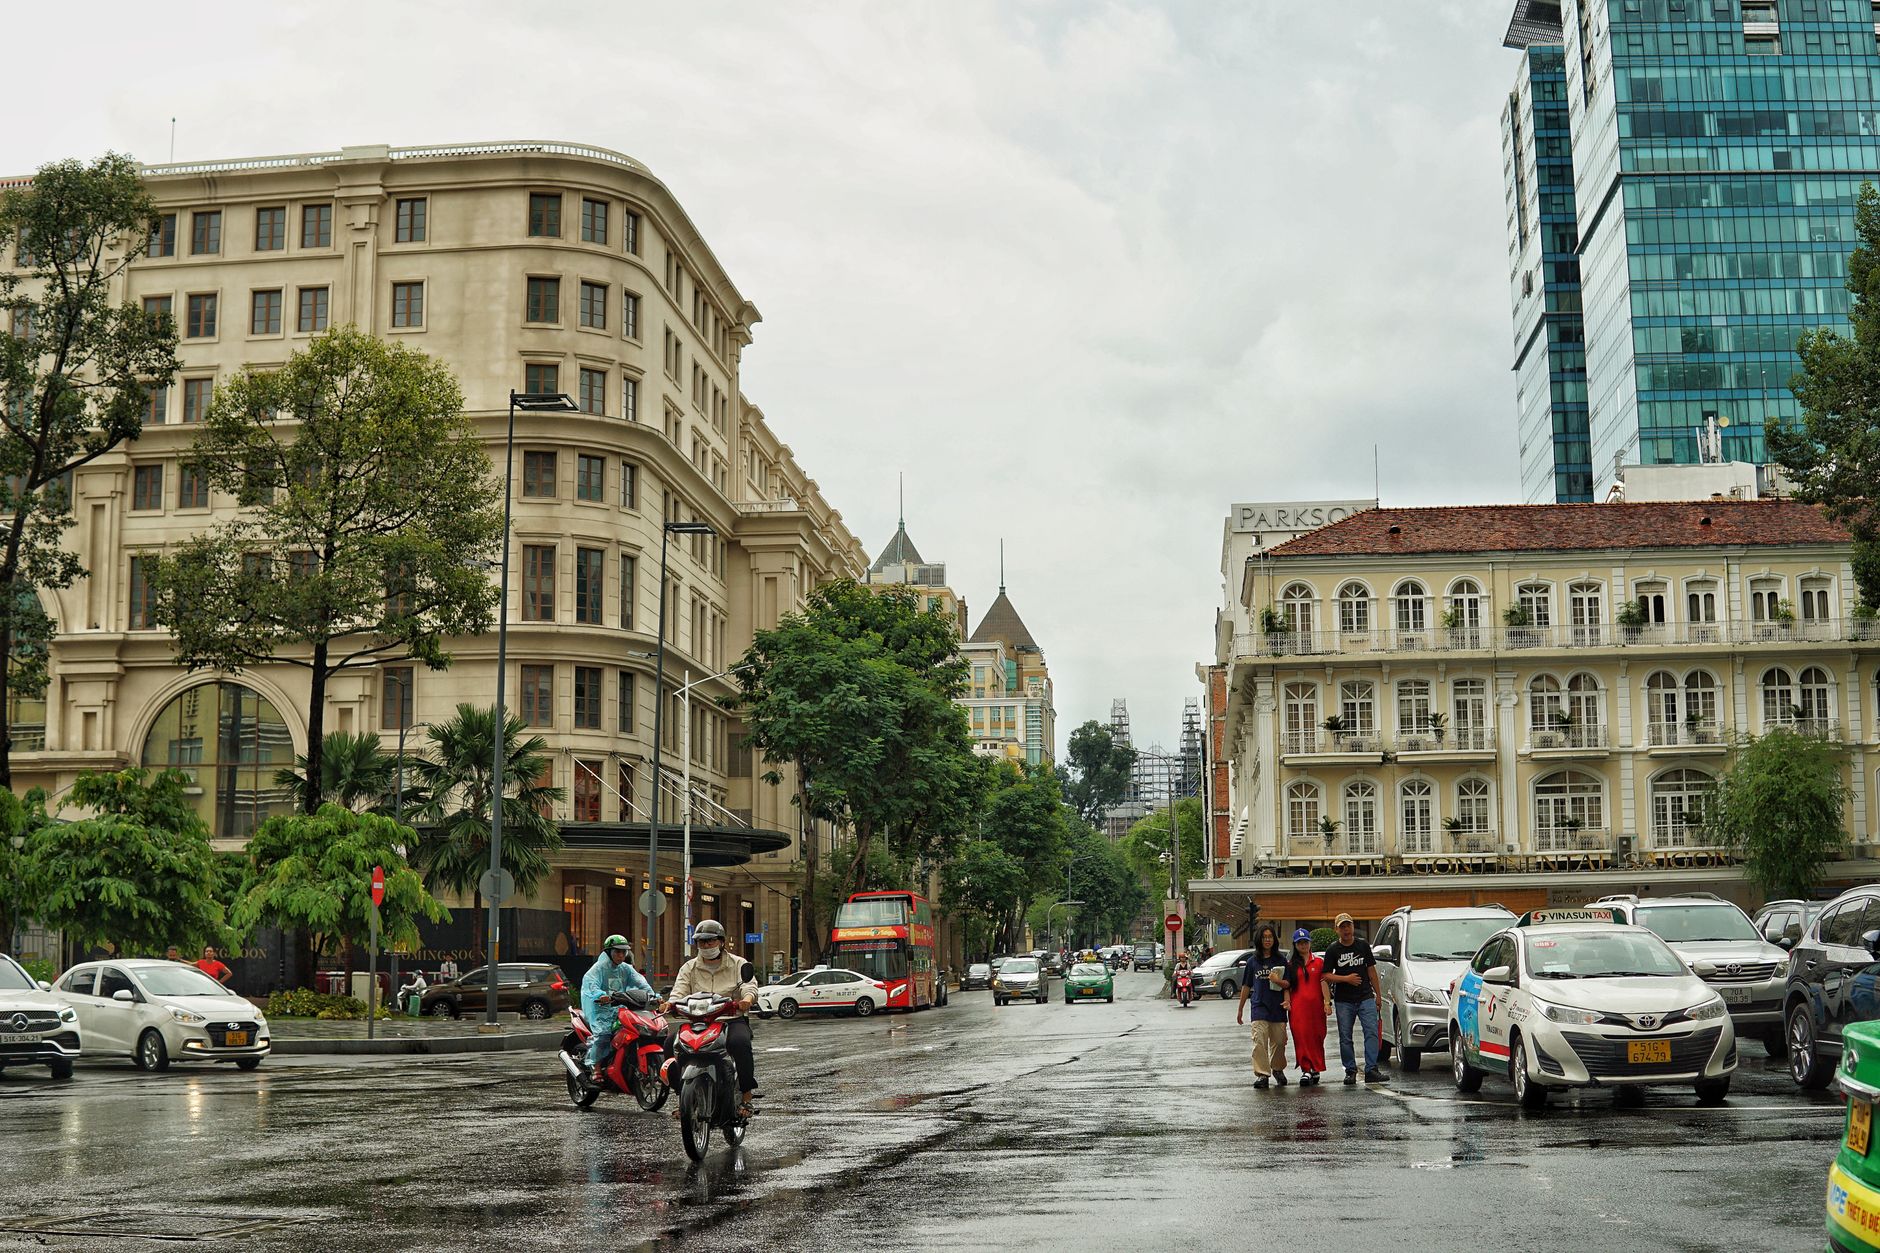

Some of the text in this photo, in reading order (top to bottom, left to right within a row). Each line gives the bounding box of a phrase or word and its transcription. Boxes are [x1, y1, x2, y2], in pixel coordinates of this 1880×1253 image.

[1625, 851, 1732, 871] SAIGON
[400, 949, 445, 960] OMING
[1340, 952, 1354, 961] JUST
[1640, 1042, 1659, 1051] 51G
[1633, 1052, 1666, 1062] 674.79
